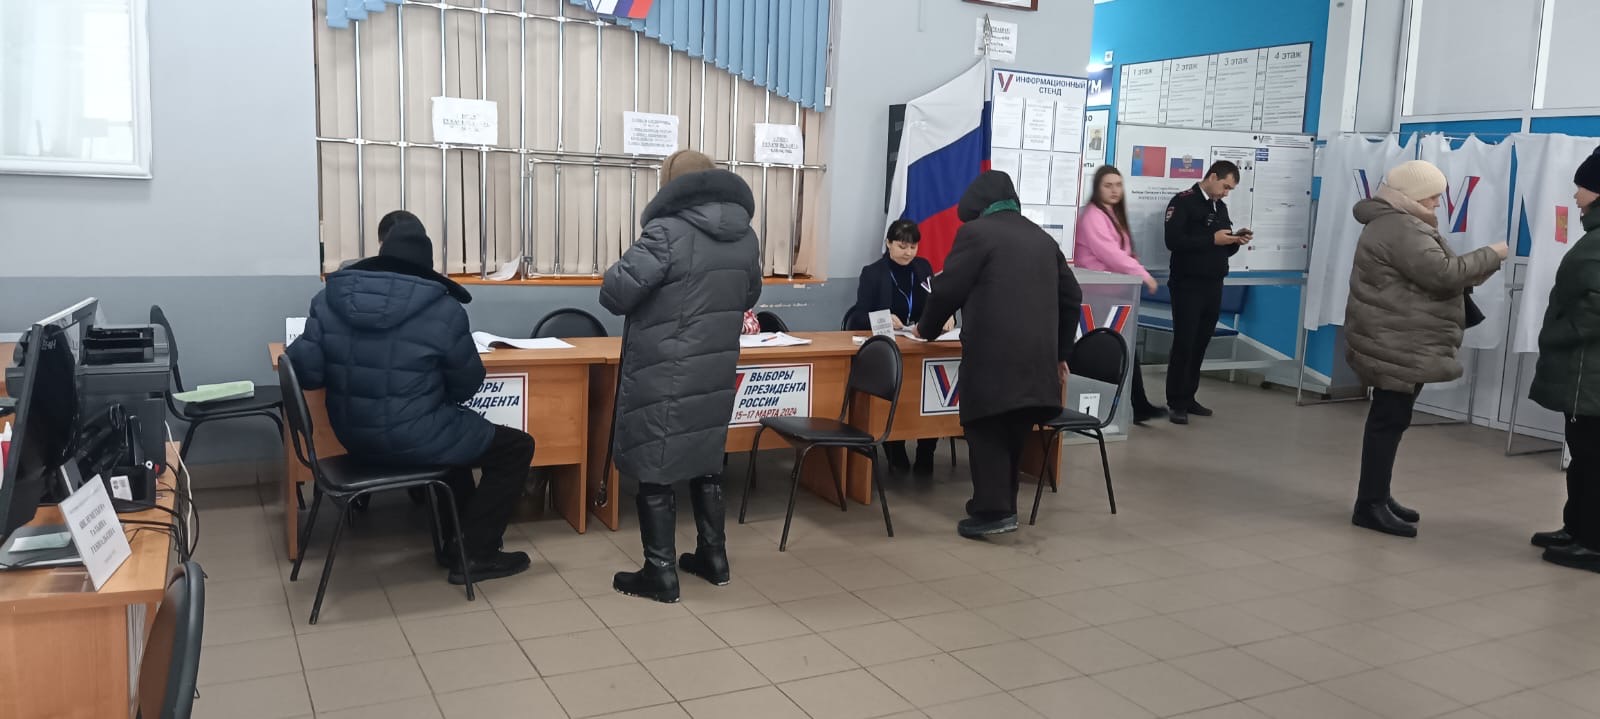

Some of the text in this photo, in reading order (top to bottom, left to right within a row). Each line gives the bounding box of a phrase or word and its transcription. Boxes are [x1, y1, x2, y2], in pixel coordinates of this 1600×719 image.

[1224, 57, 1248, 66] 3 этаж
[1274, 51, 1302, 60] 4 этаж
[1175, 63, 1199, 72] 2 этаж
[1015, 75, 1086, 89] ИНФОРМАЦИОННЫЙ
[1039, 87, 1062, 96] СТЕНД
[749, 370, 795, 382] ВЫБОРЫ
[744, 382, 807, 395] ПРЕЗИДЕНТА
[465, 395, 520, 409] ЗИДЕНТА
[738, 396, 780, 408] РОССИИ
[755, 408, 779, 419] МАРТА
[780, 407, 797, 417] 2024
